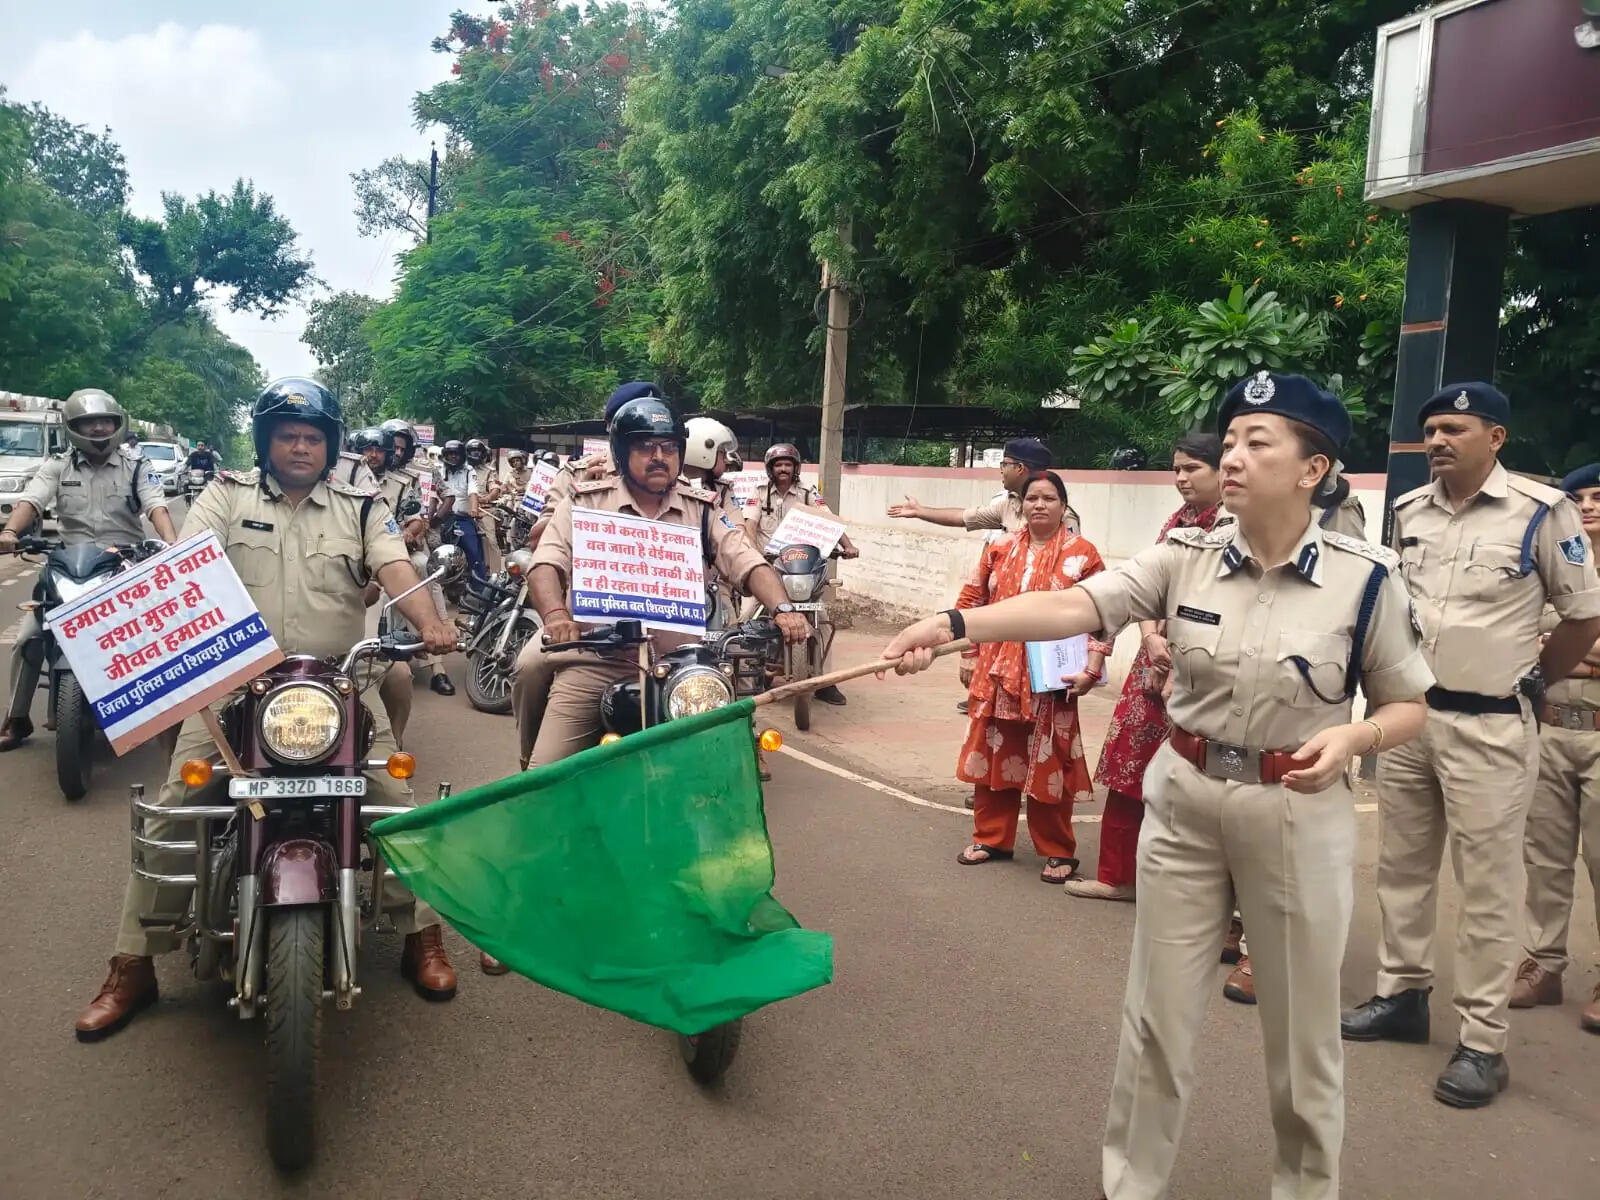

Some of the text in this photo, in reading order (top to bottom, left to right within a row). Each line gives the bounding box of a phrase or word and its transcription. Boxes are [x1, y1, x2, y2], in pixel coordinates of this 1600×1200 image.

[573, 518, 598, 532] नशा
[601, 520, 616, 535] जो
[619, 527, 649, 539] करता
[648, 526, 659, 543] है
[608, 542, 635, 556] जाता
[636, 542, 647, 558] है
[573, 556, 704, 584] इज्जत न रहती उसकी और
[59, 544, 224, 639] हमारा एक ही नारा,
[582, 576, 593, 588] न
[595, 574, 608, 590] ही
[610, 579, 638, 594] रहता
[640, 581, 660, 595] धर्म
[96, 581, 205, 651] नशा मुक्त हो
[575, 592, 599, 608] जिला
[601, 596, 628, 613] पुलिस
[645, 600, 679, 619] शिवपुरी
[104, 606, 226, 681] जीवन हमारा।
[96, 694, 130, 719] जिला
[128, 675, 164, 706] पुलिस
[163, 665, 185, 681] बल
[183, 637, 229, 671] शिवपुरी
[249, 781, 269, 795] MP
[276, 780, 317, 794] 33ZD
